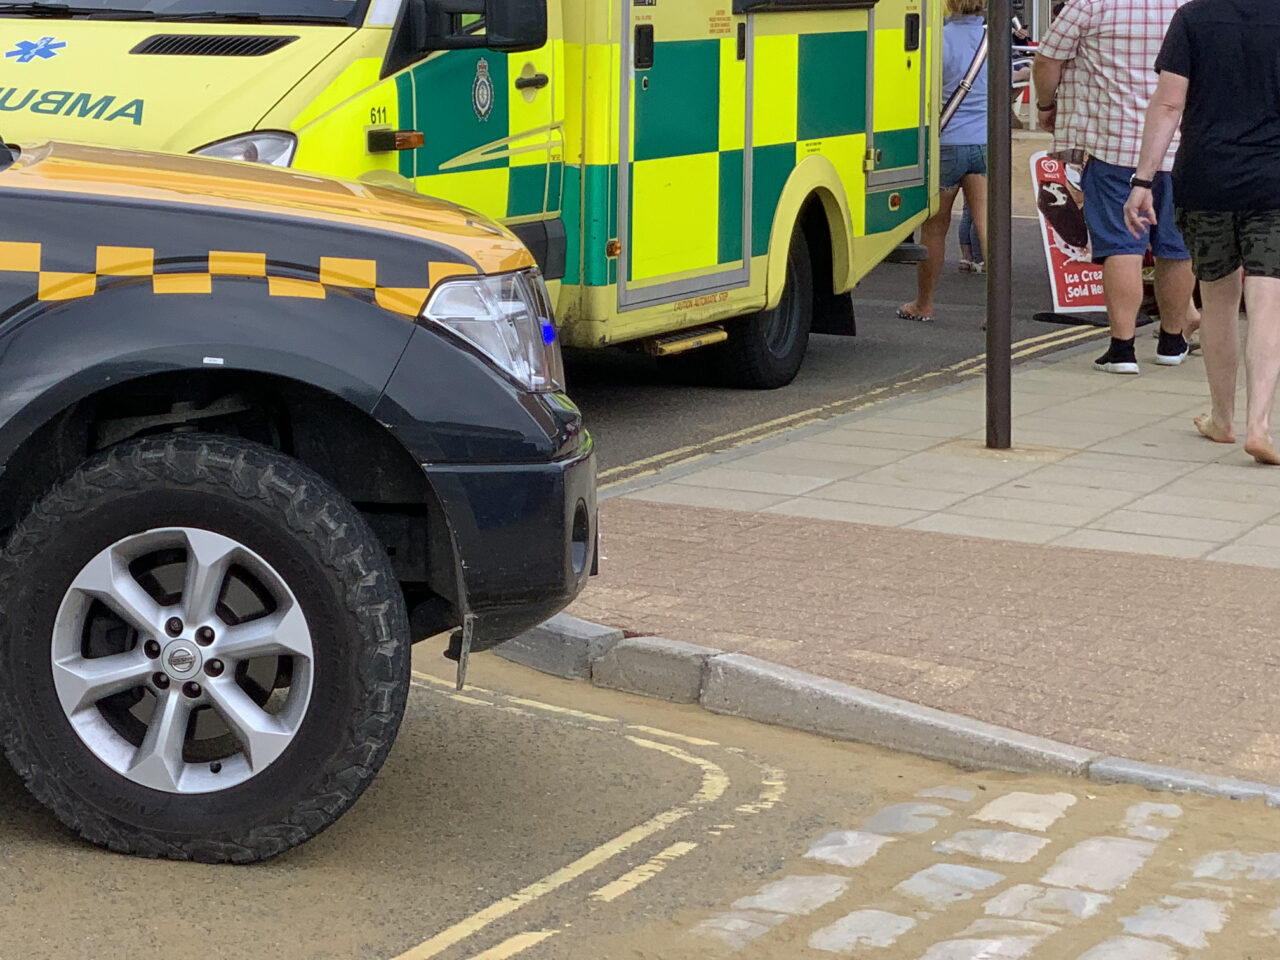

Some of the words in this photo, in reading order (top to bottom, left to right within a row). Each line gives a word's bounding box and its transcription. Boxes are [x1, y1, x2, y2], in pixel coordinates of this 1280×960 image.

[370, 106, 387, 124] 611
[1064, 272, 1079, 284] Ice
[1081, 270, 1103, 282] Crea
[1067, 284, 1089, 298] Sold
